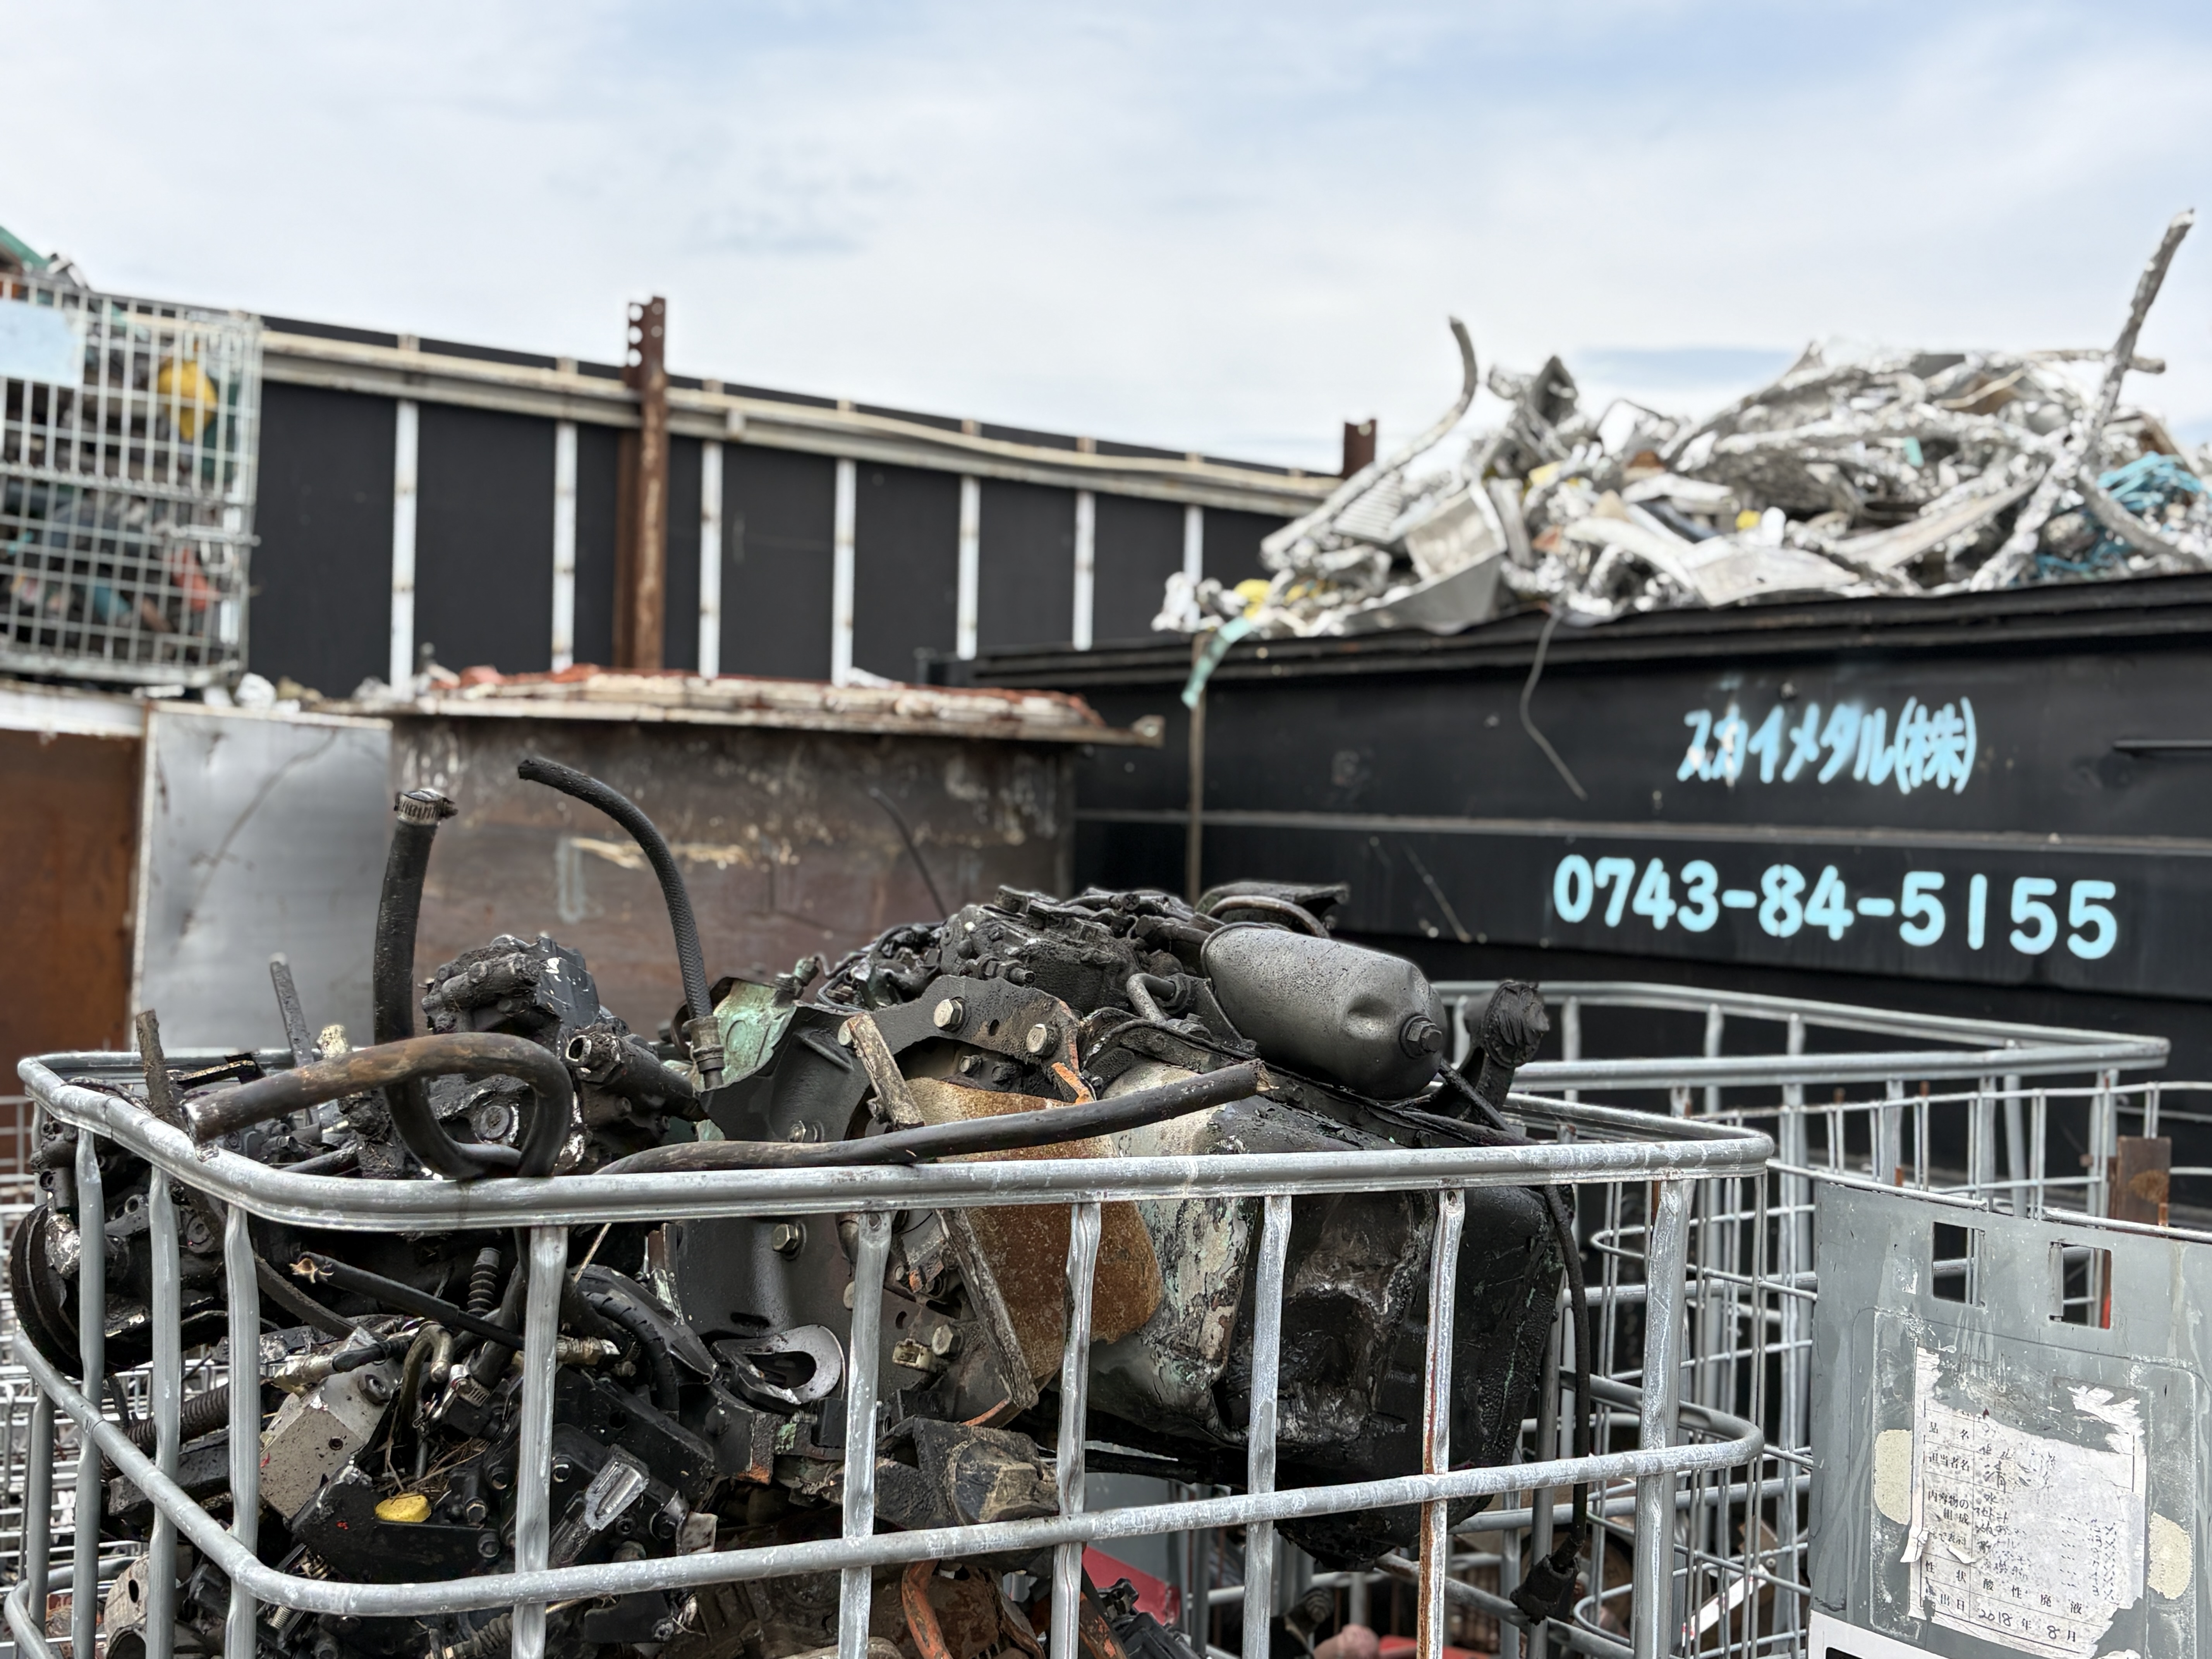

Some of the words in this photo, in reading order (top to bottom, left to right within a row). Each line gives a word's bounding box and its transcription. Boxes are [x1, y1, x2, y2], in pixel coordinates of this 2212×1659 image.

[1677, 696, 1977, 794] スカイメタル(株)
[1553, 854, 2118, 960] 0743-84-5155
[1928, 1490, 1969, 1510] 内容物の
